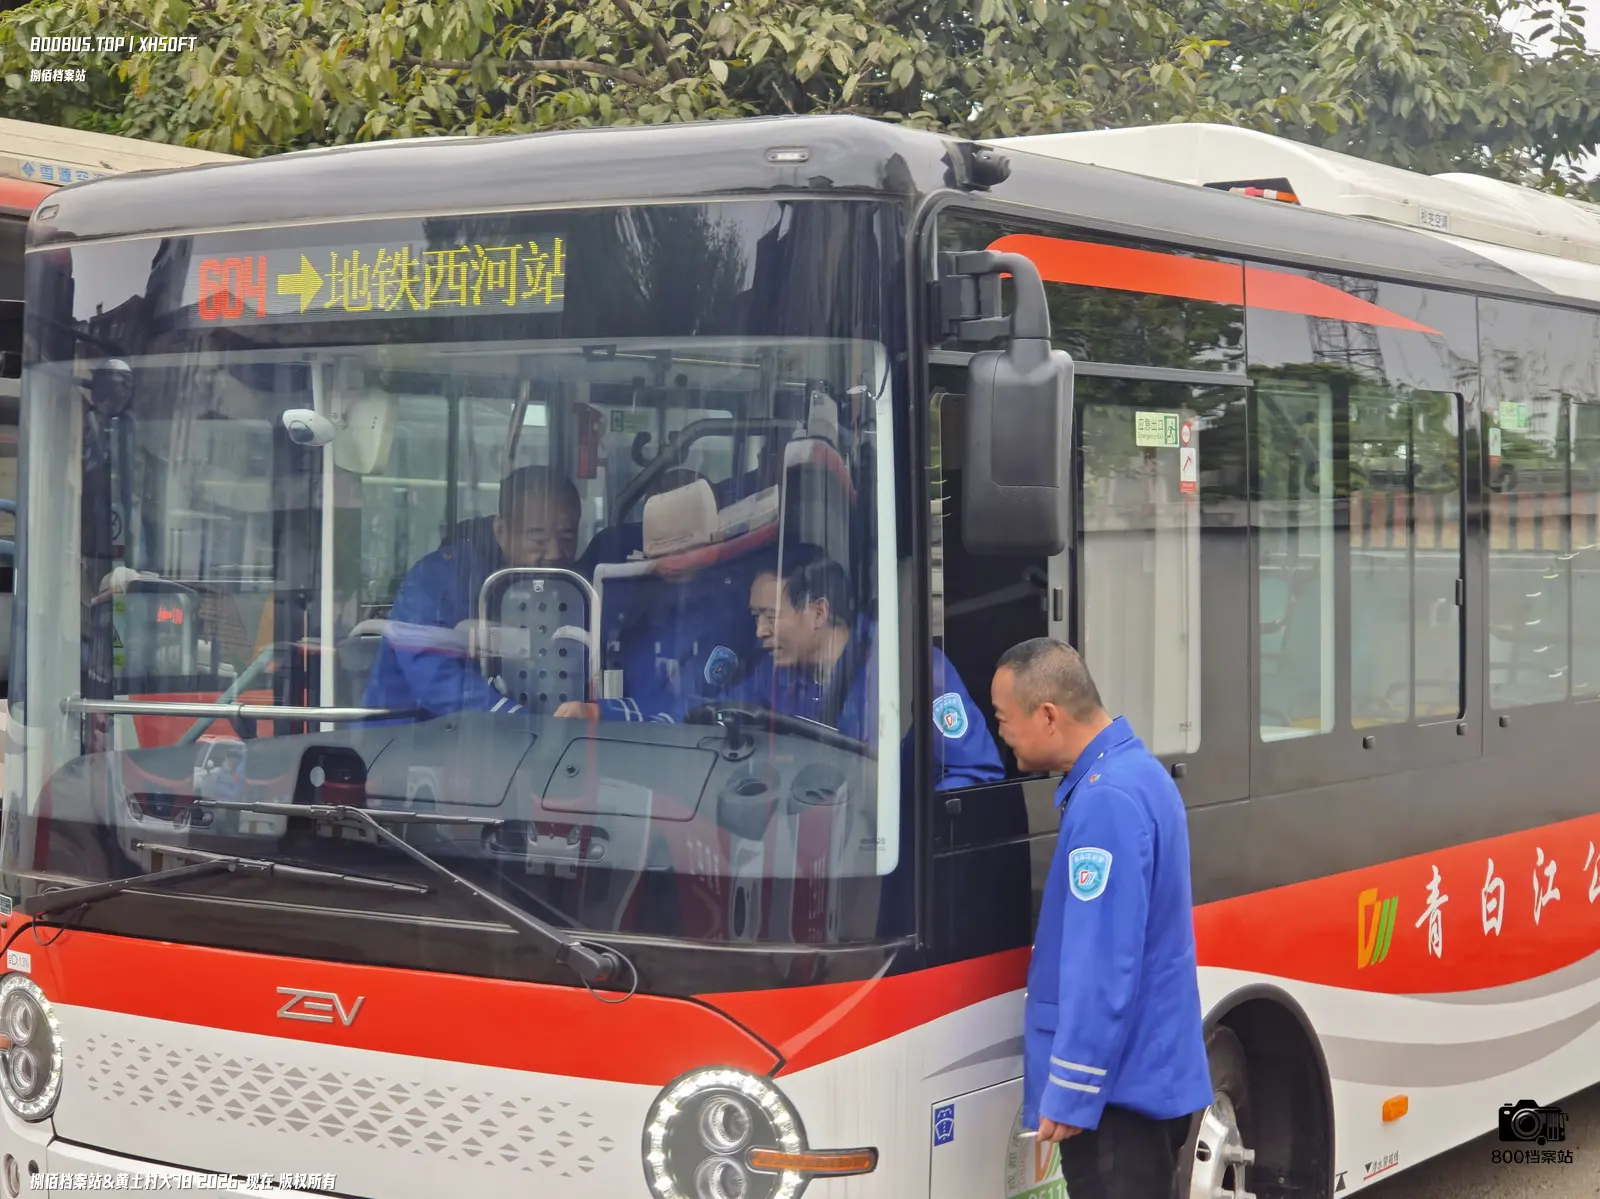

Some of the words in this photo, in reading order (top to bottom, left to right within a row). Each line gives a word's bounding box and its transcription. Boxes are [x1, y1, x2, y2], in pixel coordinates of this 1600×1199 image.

[199, 255, 268, 320] 604
[323, 237, 565, 312] 地铁西河站
[276, 986, 365, 1026] ZEV
